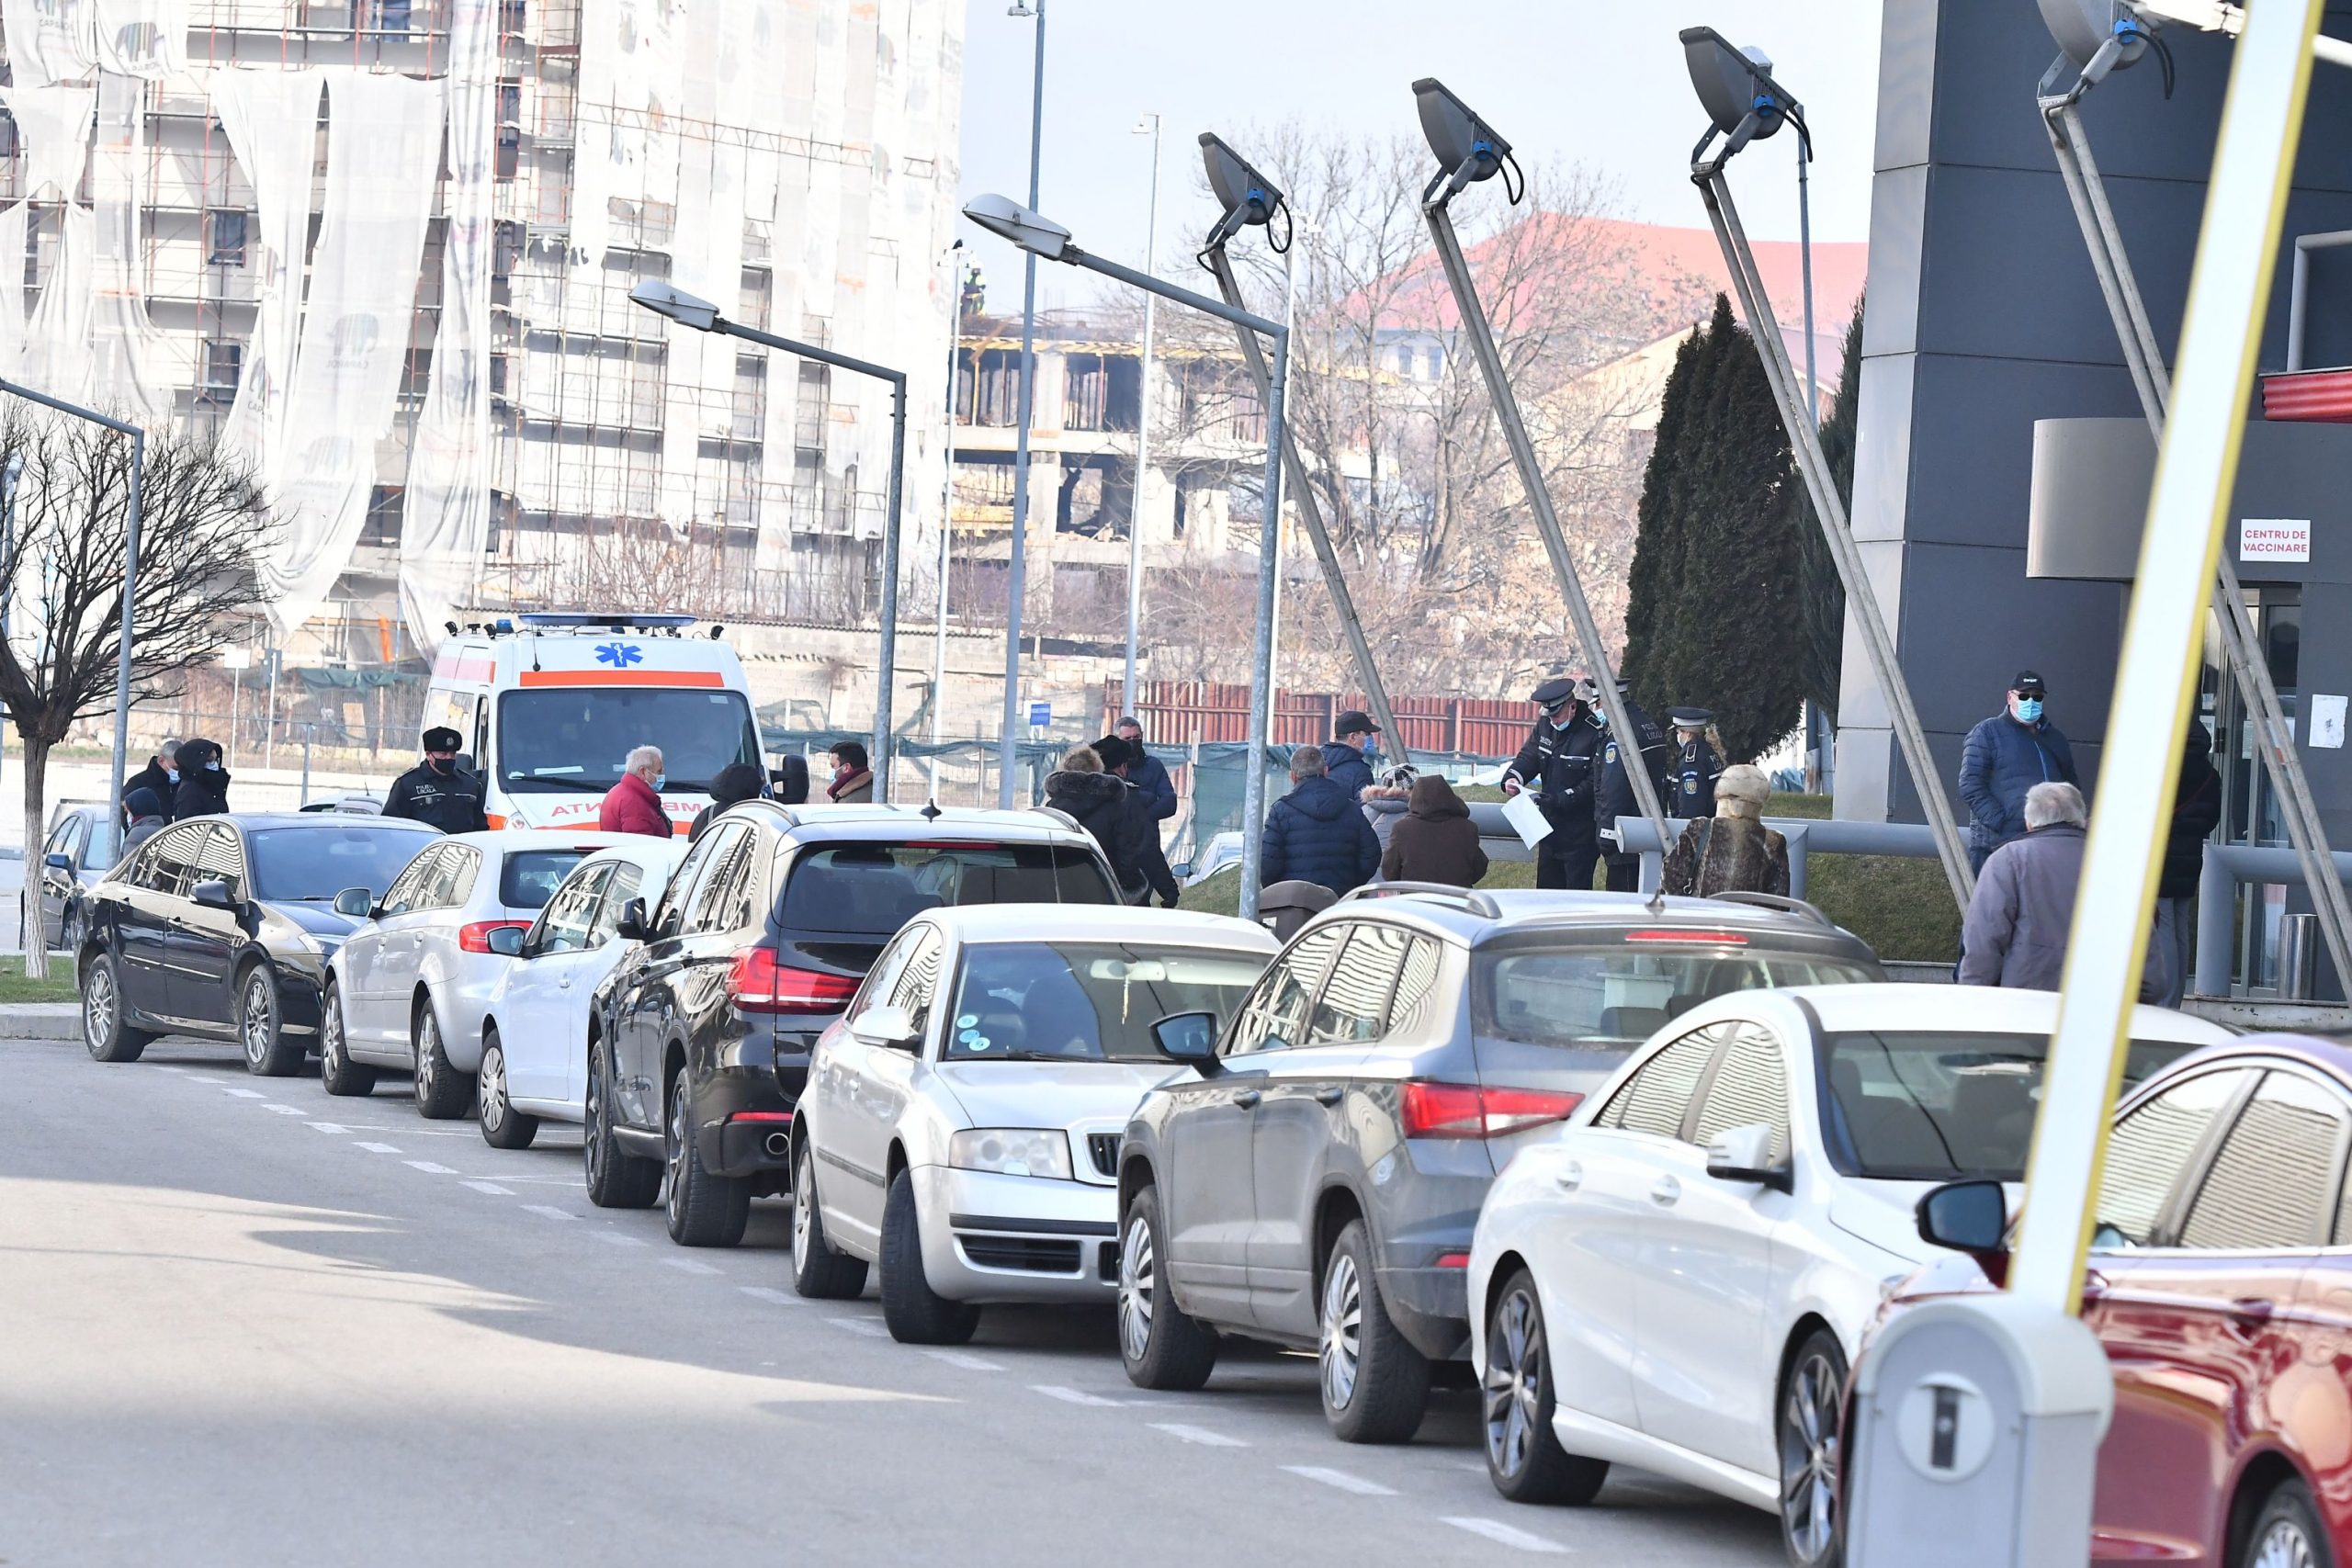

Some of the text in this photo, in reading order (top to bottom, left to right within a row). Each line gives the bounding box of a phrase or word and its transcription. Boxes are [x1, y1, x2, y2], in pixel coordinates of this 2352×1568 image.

[2245, 529, 2307, 539] CENTRU DE
[2244, 543, 2308, 553] VACCINARE
